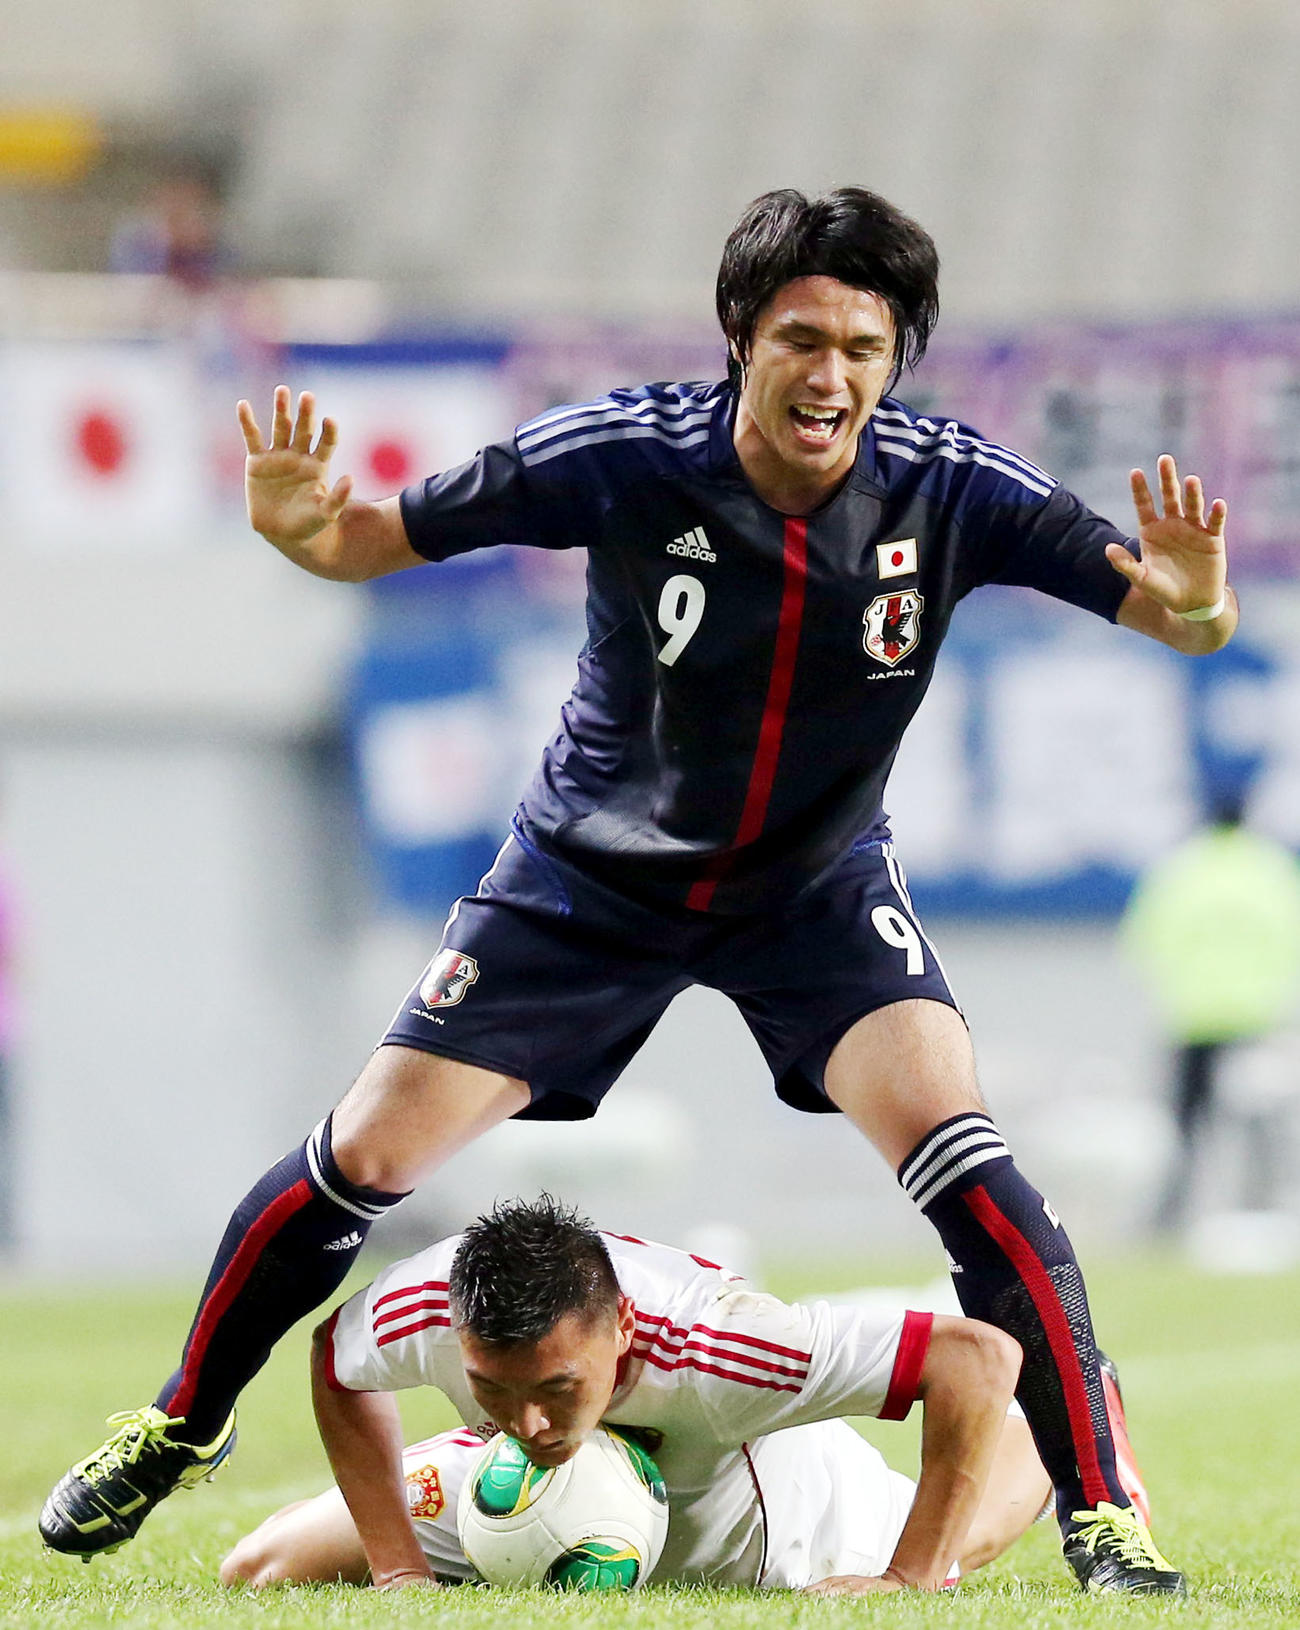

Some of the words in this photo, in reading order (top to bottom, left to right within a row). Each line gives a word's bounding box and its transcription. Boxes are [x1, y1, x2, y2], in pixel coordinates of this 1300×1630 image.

[666, 543, 717, 563] adidas
[657, 574, 706, 667] 9
[866, 669, 916, 680] JAPAN
[871, 905, 925, 976] 9
[409, 1007, 445, 1025] JAPAN
